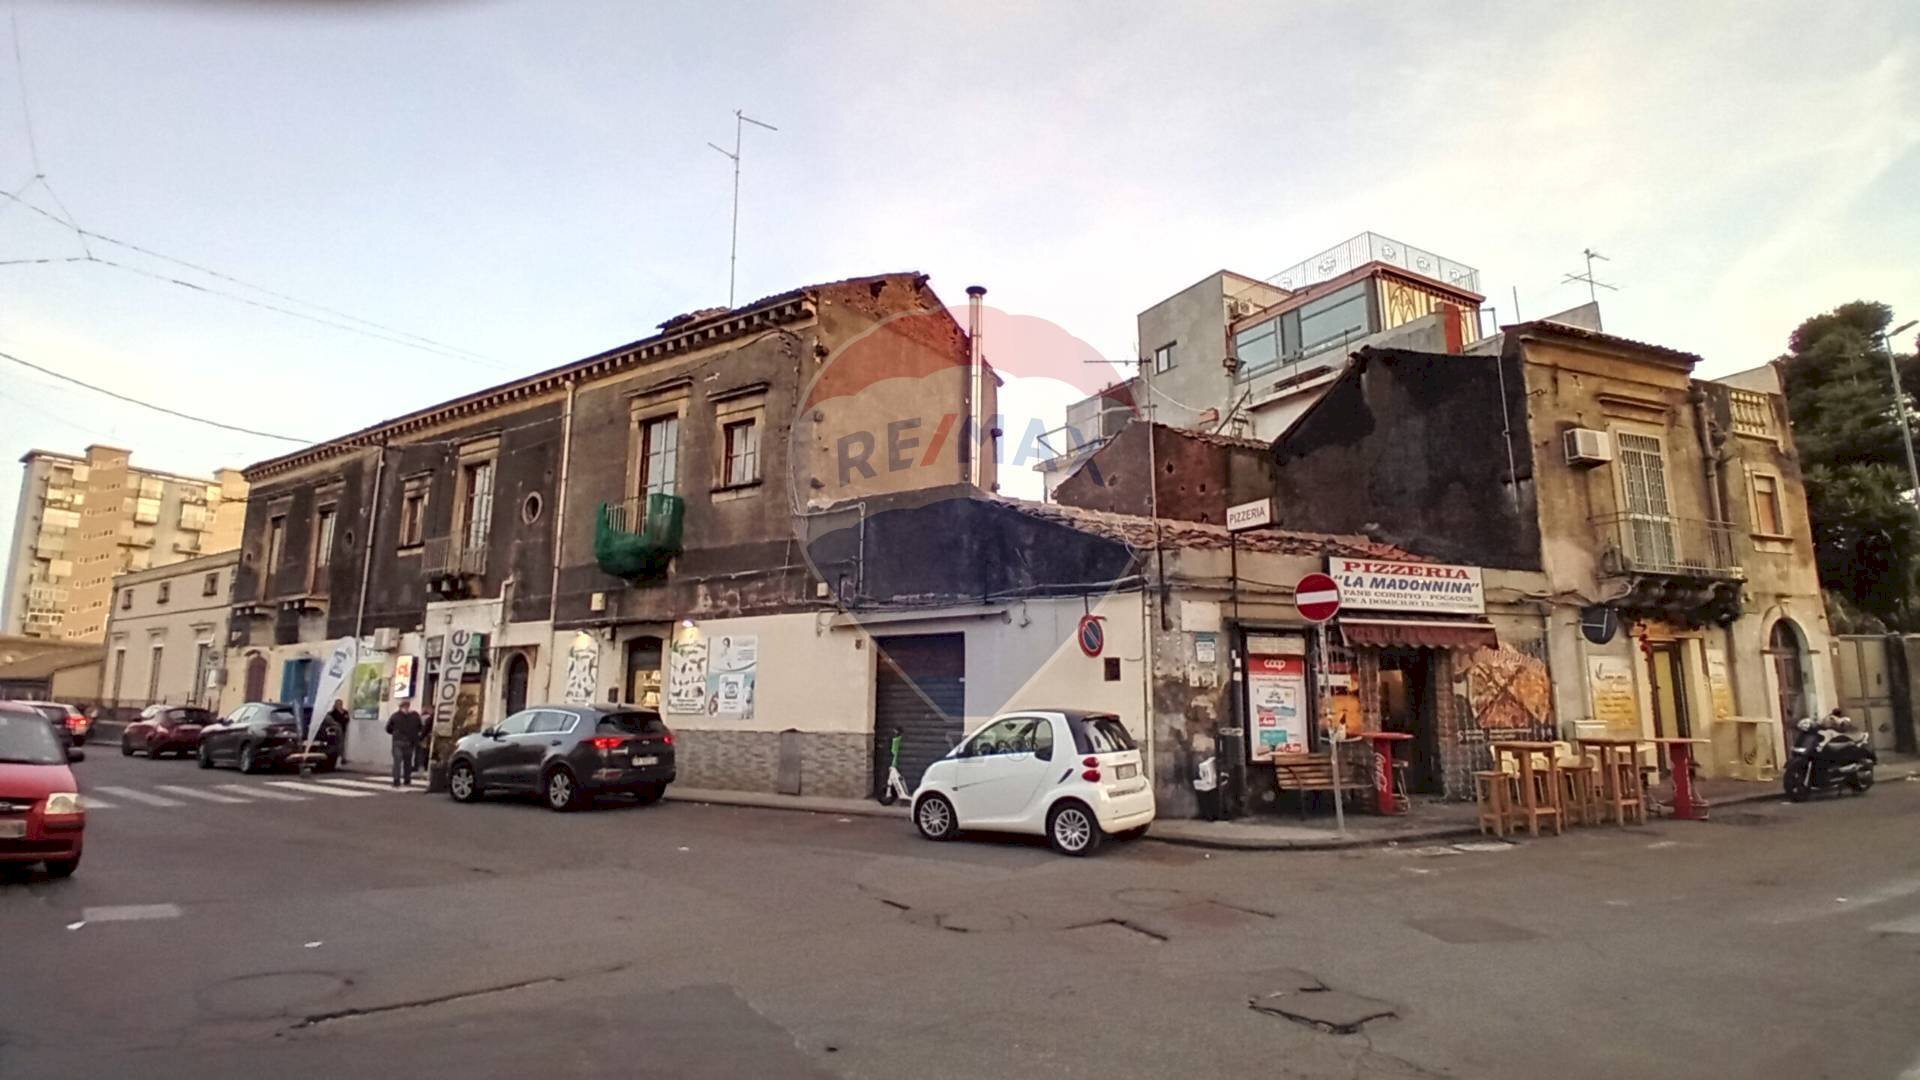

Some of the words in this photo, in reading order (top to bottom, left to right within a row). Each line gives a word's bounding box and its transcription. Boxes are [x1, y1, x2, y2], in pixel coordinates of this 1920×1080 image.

[1229, 506, 1266, 525] PIZZERIA
[1343, 561, 1471, 580] PIZZERIA
[1344, 589, 1372, 597] PANE
[1374, 591, 1421, 600] CONDITO
[1263, 659, 1287, 673] coop
